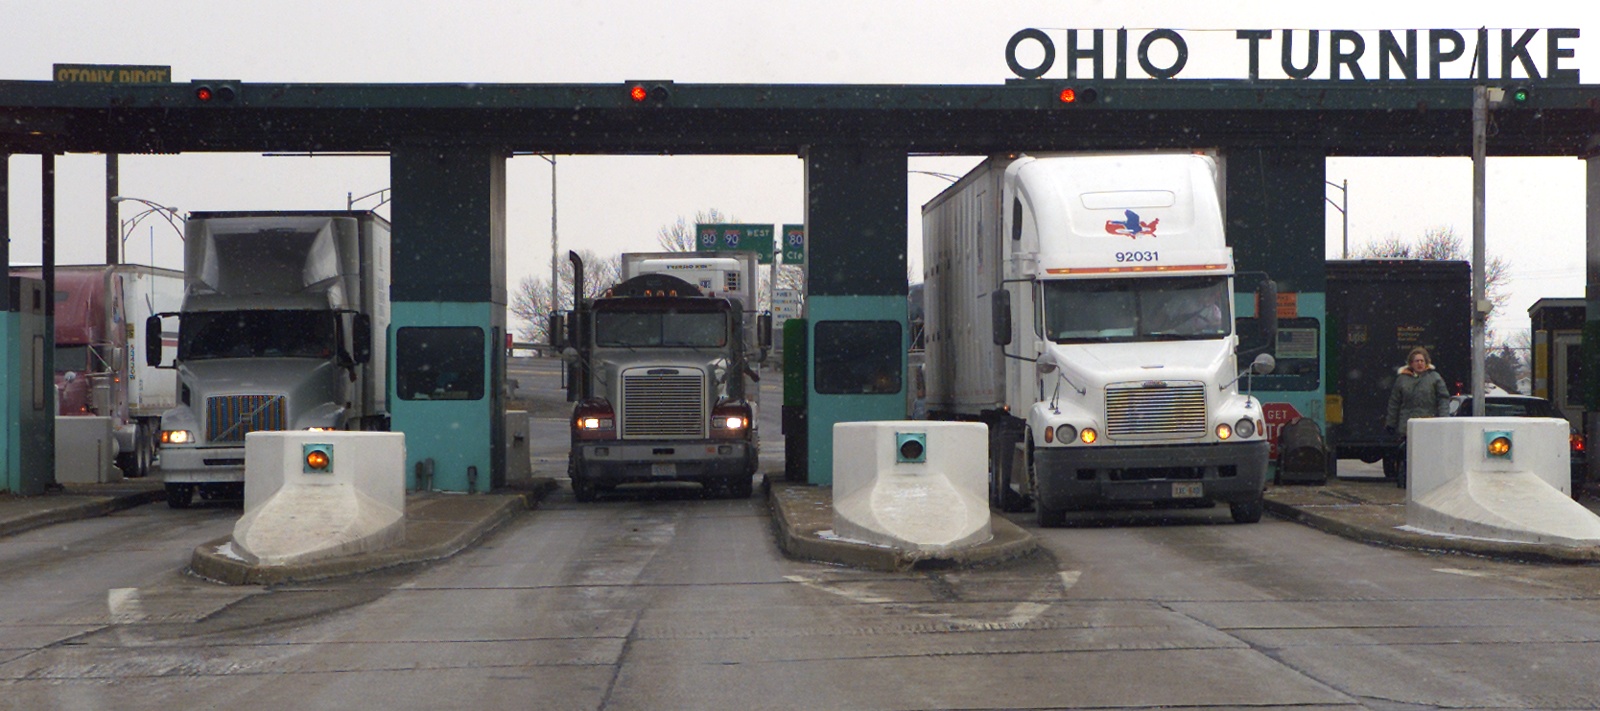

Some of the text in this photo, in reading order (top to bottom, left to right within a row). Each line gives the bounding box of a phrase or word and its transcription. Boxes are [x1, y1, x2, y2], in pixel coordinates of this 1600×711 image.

[1005, 28, 1581, 80] OHIO TURNPIKE
[702, 229, 770, 244] 80 90 WEST
[789, 234, 803, 245] 80
[1115, 251, 1159, 262] 92031
[1267, 410, 1287, 420] GET
